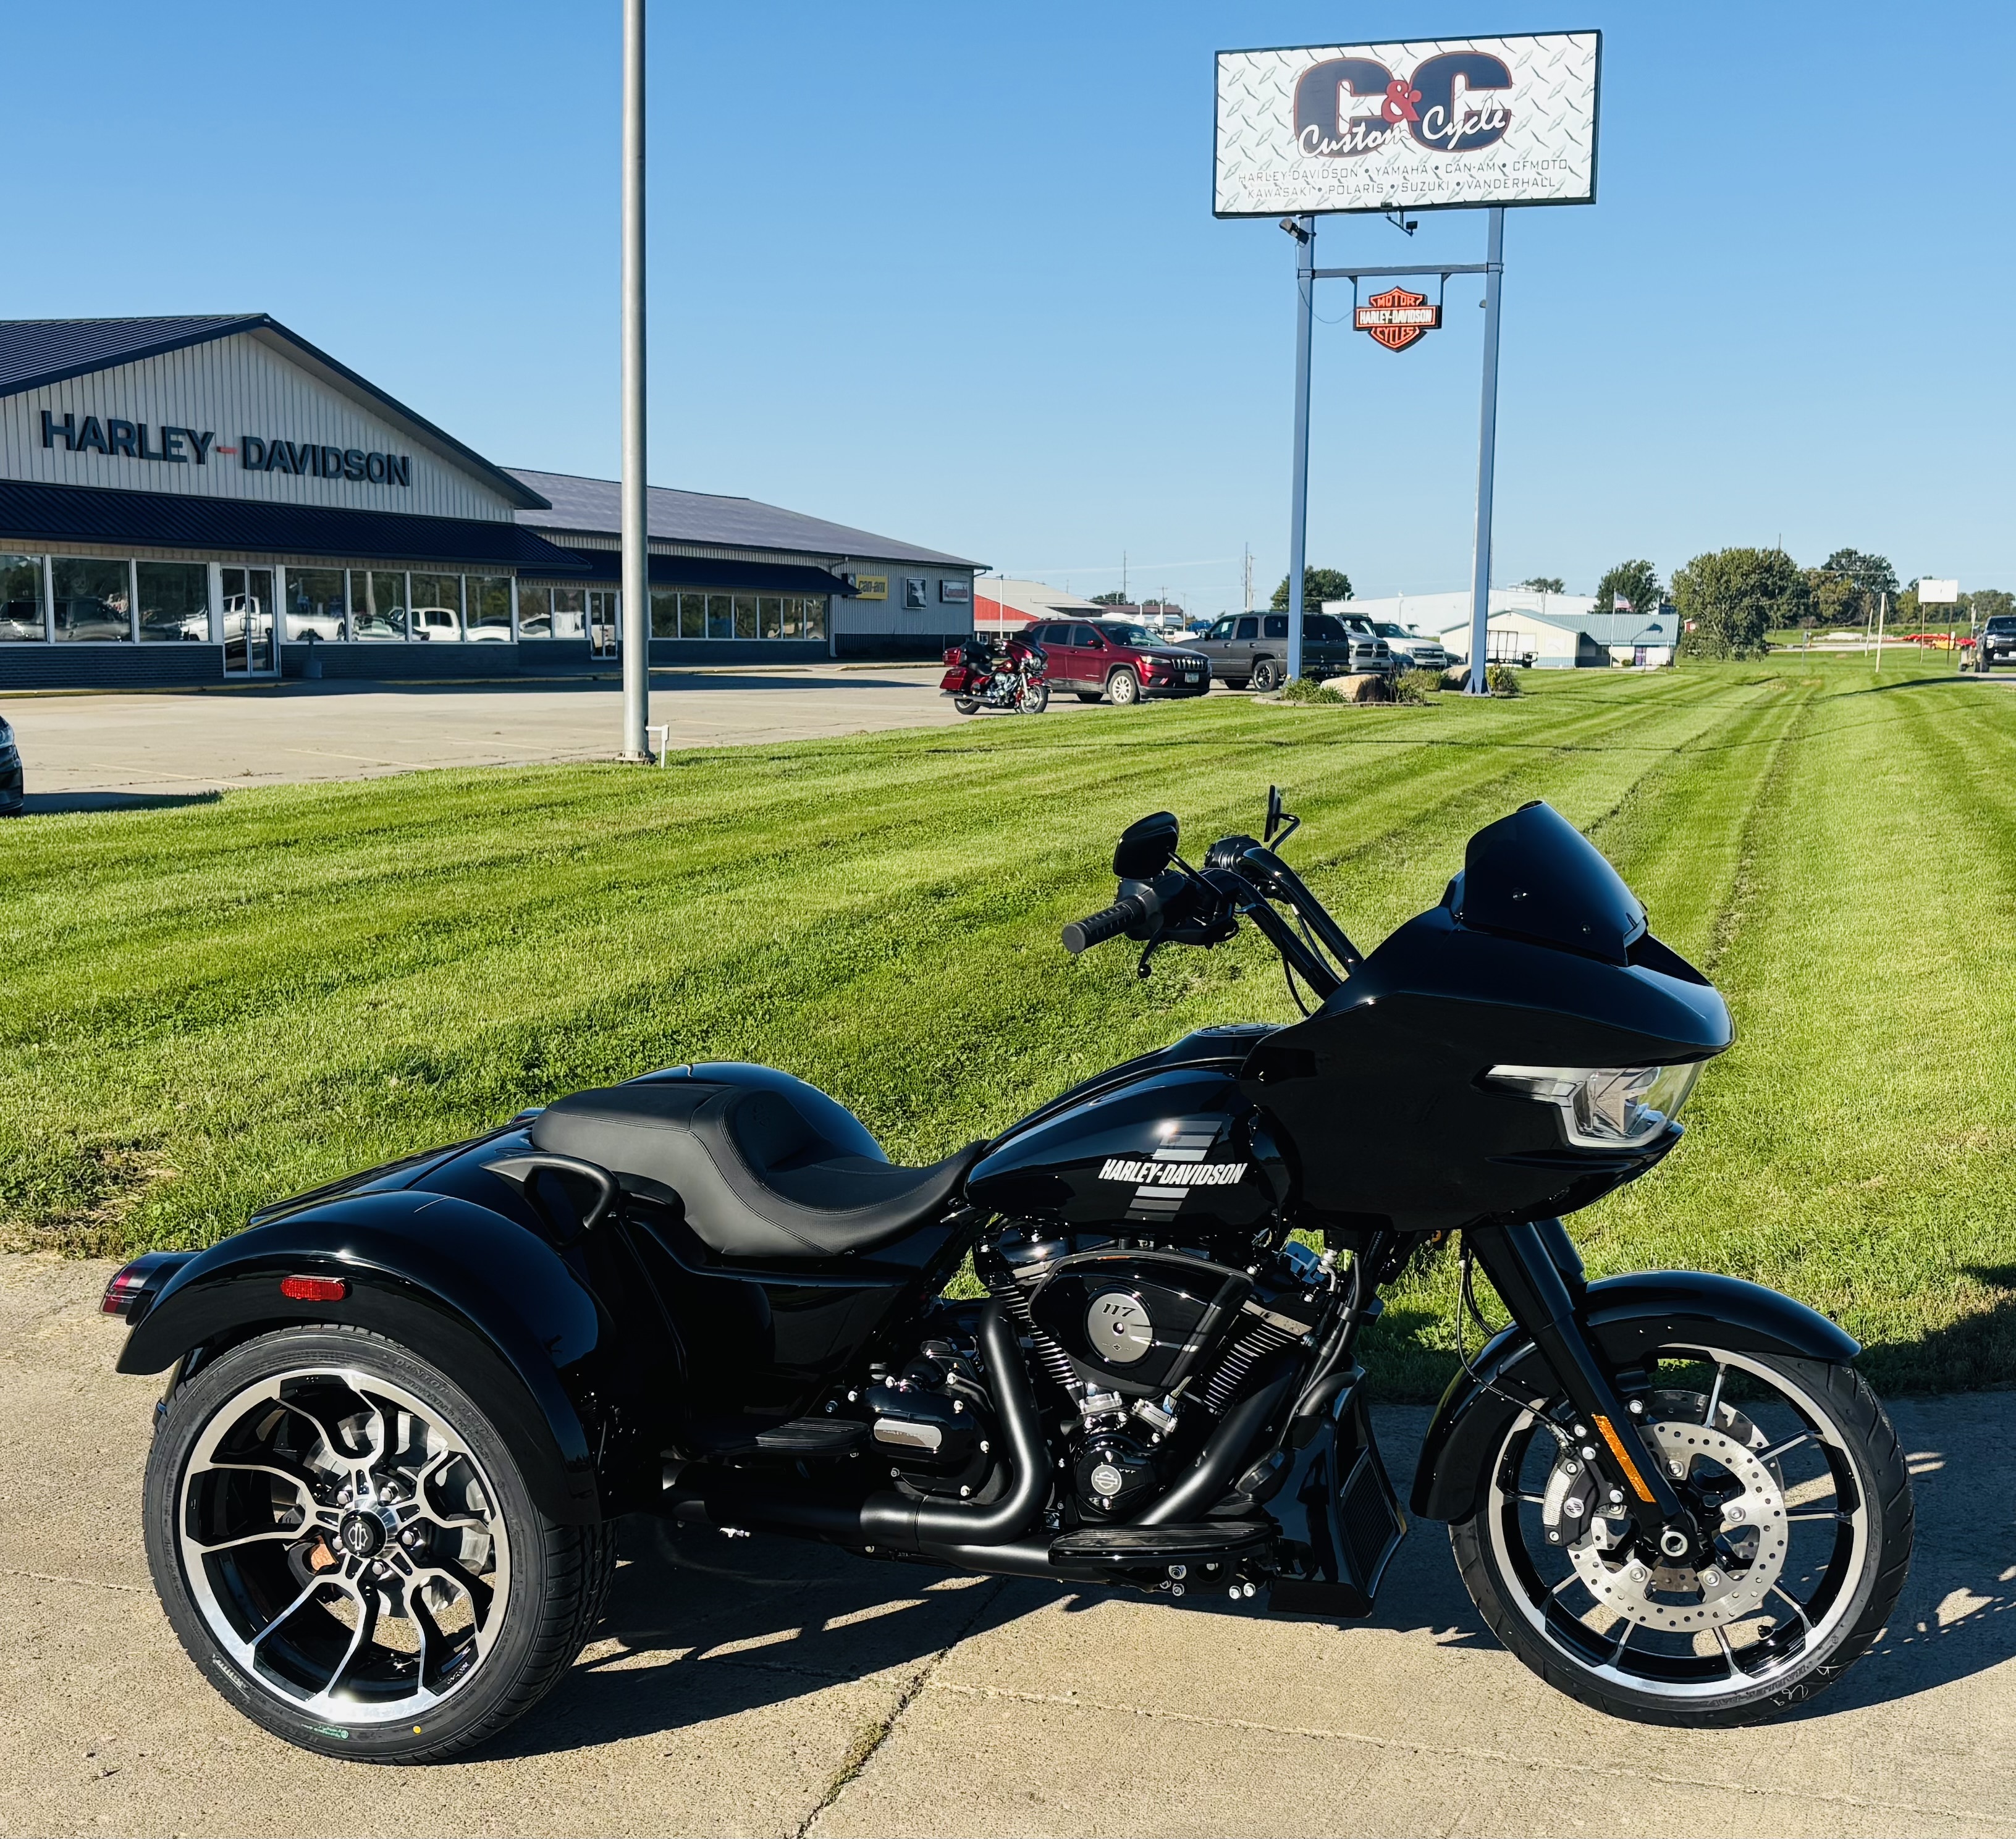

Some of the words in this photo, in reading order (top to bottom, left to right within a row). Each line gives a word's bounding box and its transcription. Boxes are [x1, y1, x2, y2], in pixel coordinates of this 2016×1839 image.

[1294, 51, 1512, 158] C&C
[1298, 122, 1412, 158] Custom
[1422, 98, 1506, 149] Cycle
[1238, 168, 1358, 183] HARLEY-DAVIDSON
[1375, 164, 1428, 177] YAMAHA
[1513, 159, 1567, 171] CFMOTO
[1247, 187, 1312, 199] KAWASAKI
[1328, 183, 1383, 195] POLARIS
[1401, 181, 1449, 192] SUZUKI
[1466, 177, 1556, 190] VANDERHALL
[1377, 292, 1415, 307] MOTOR
[1360, 309, 1432, 324] HARLEY-DAVIDSON
[1377, 327, 1414, 344] CYCLES
[1098, 1159, 1247, 1185] HARLEY-DAVIDSON
[1102, 1303, 1137, 1317] 117
